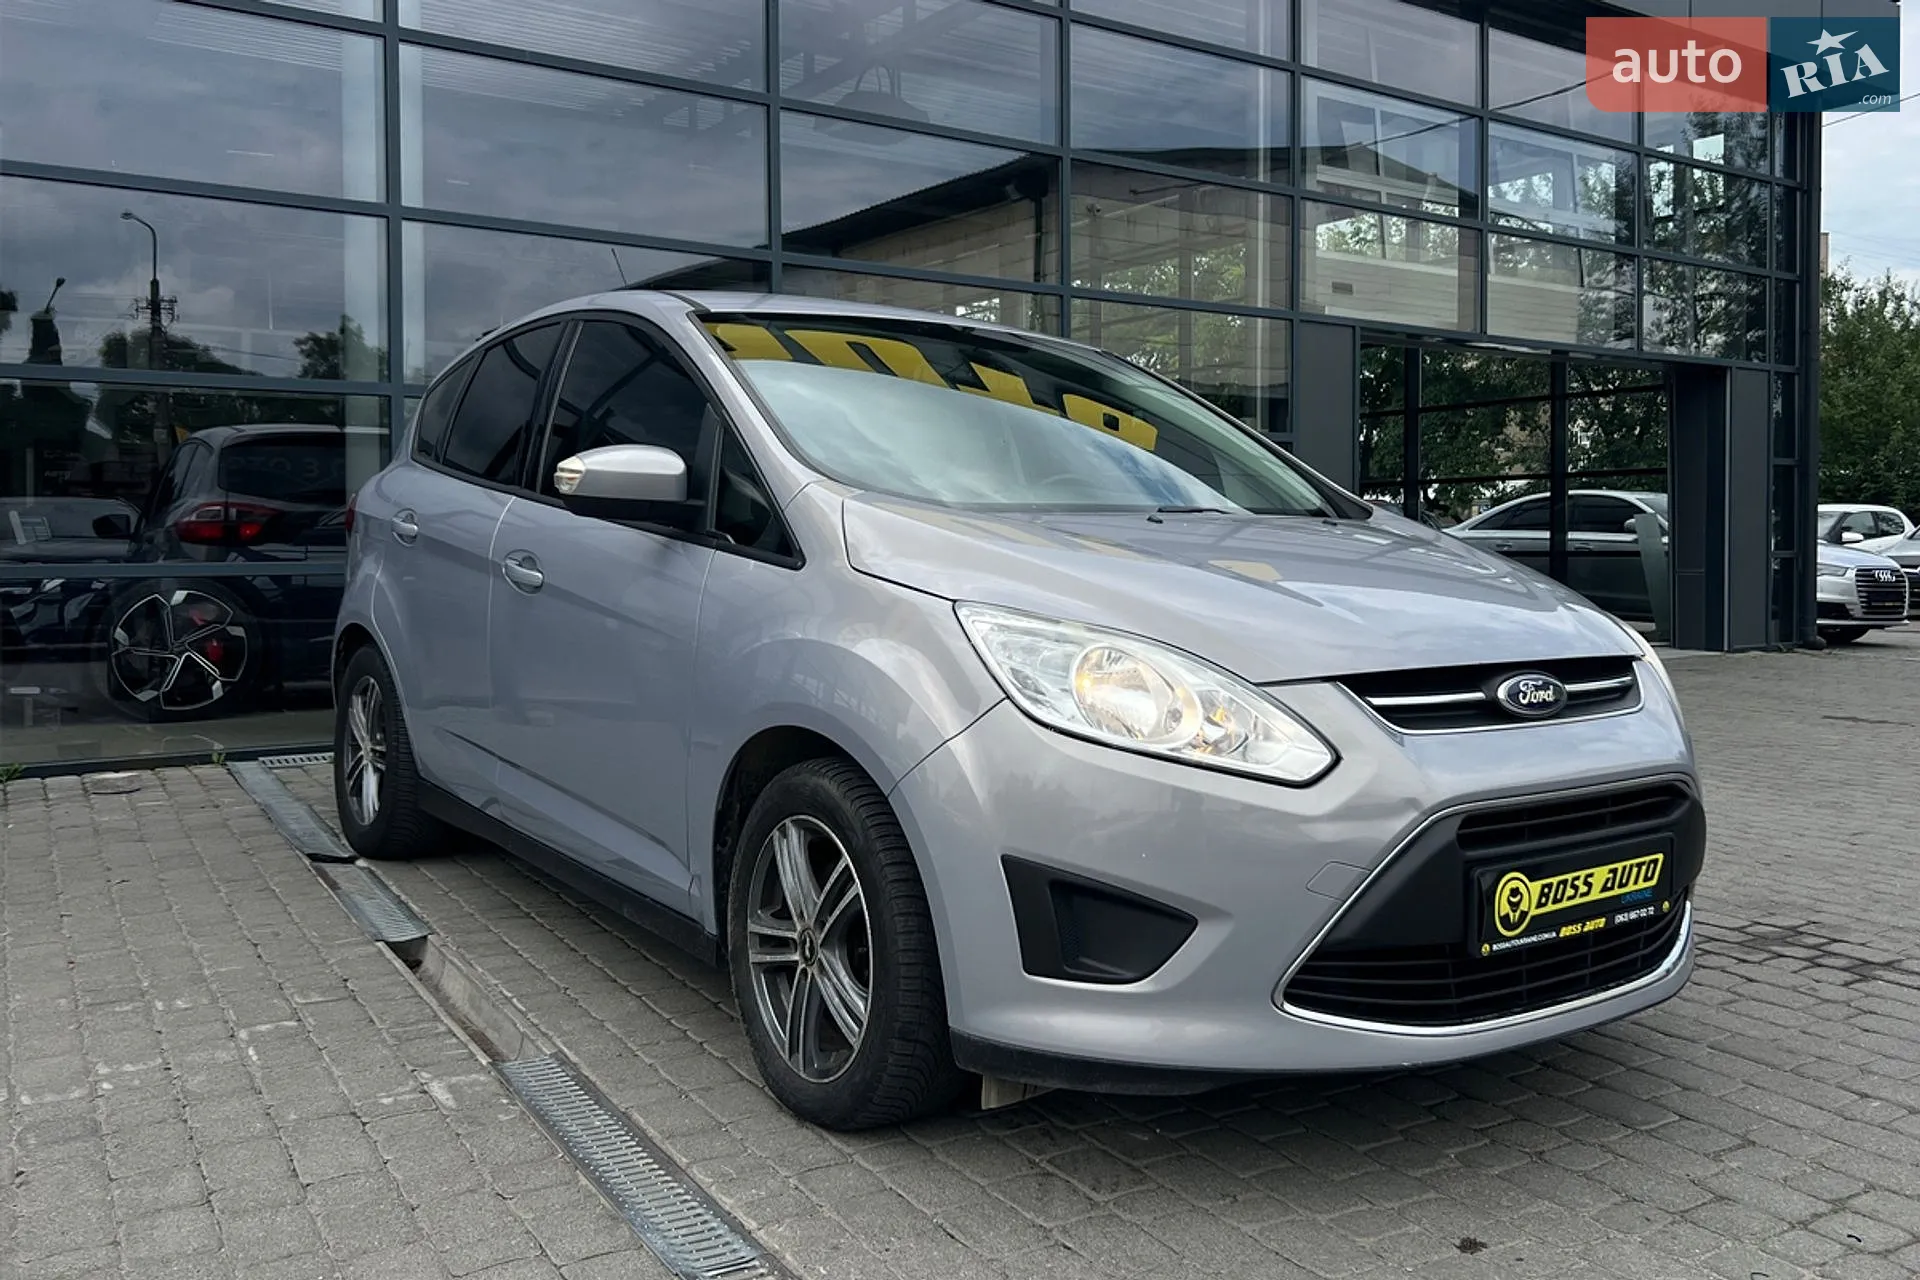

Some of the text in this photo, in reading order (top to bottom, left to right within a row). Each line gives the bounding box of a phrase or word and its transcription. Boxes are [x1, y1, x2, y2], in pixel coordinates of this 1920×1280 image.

[1519, 680, 1555, 704] Ford
[1535, 857, 1660, 909] BOSS AUTO
[1559, 917, 1606, 937] BOSS AUTO
